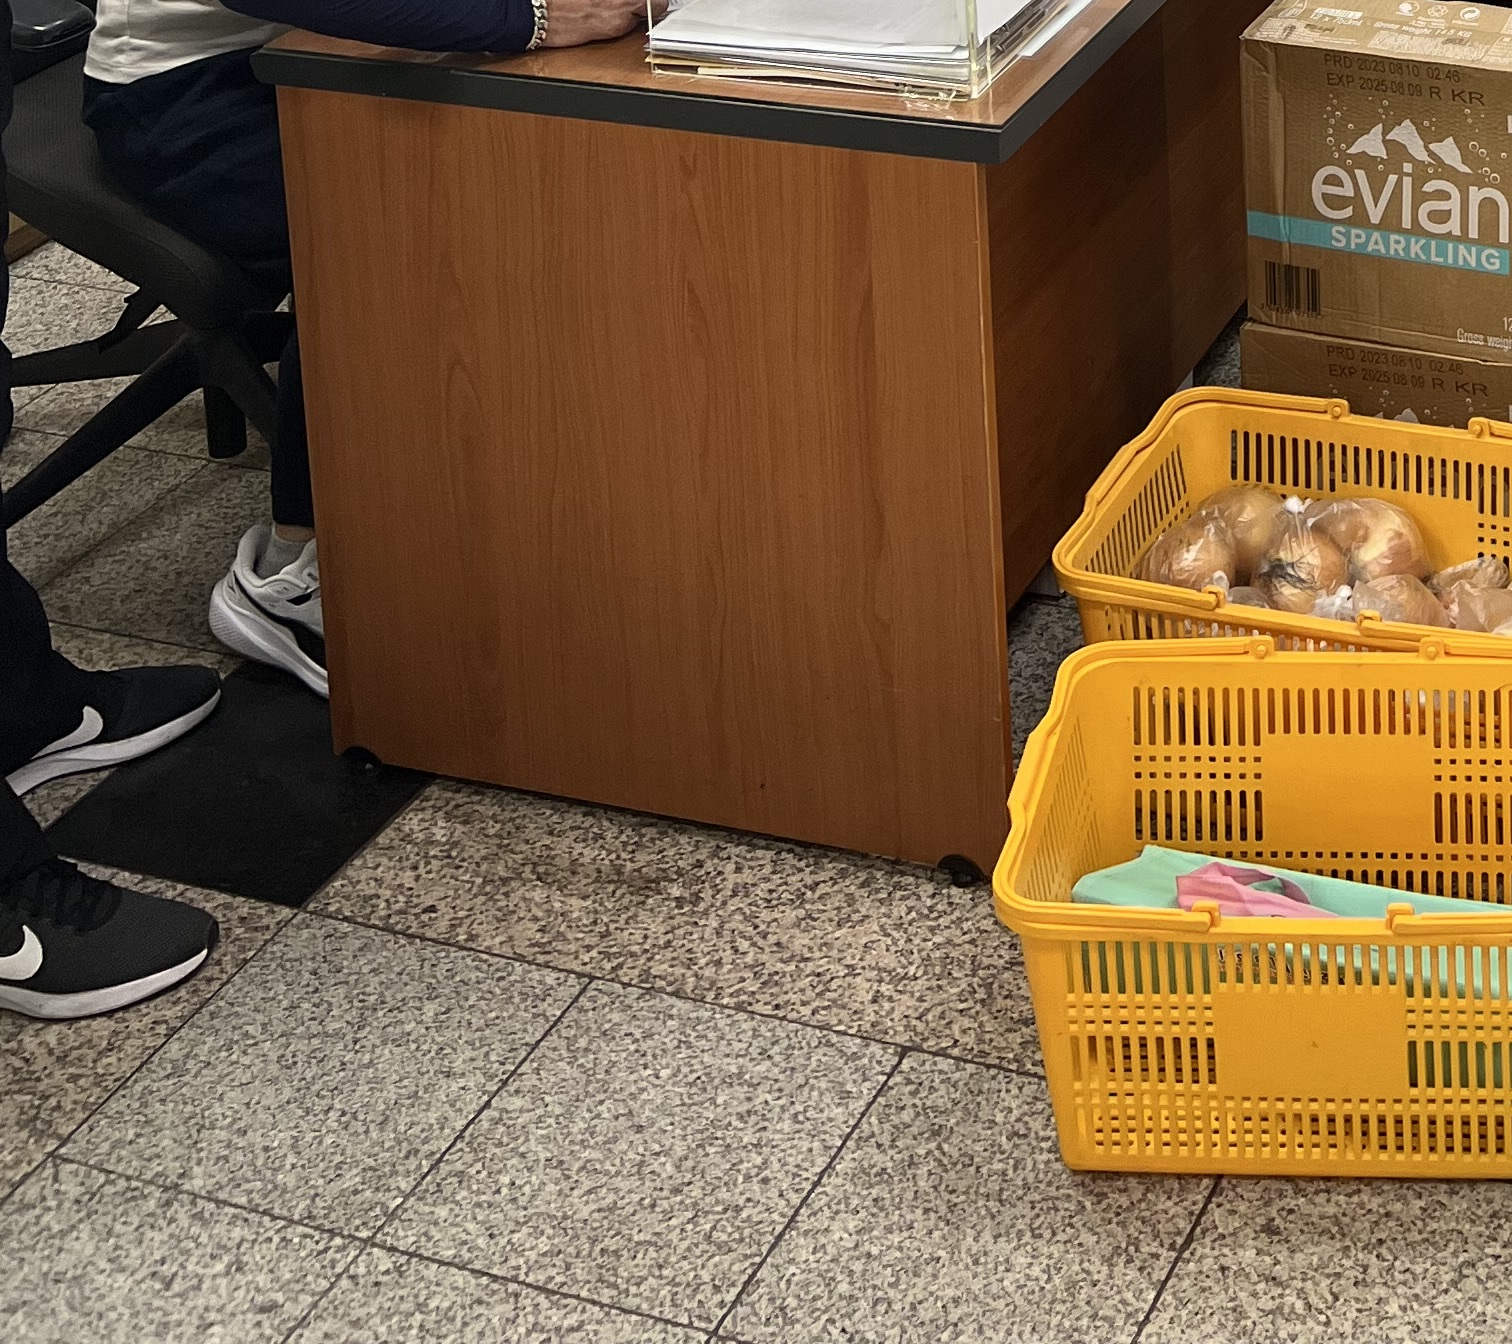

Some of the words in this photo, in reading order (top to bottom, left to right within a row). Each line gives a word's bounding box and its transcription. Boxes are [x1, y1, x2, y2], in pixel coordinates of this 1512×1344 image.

[1323, 53, 1353, 69] PRD
[1357, 57, 1386, 74] 2023
[1326, 72, 1354, 87] EXP
[1358, 76, 1388, 93] 2025
[1429, 85, 1443, 100] R
[1451, 88, 1486, 106] KR
[1331, 225, 1501, 270] SPARKLING
[1456, 327, 1485, 345] Gross
[1326, 345, 1355, 362] PRD
[1328, 364, 1358, 380] EXP
[1431, 378, 1445, 391] R
[1455, 381, 1489, 397] KR
